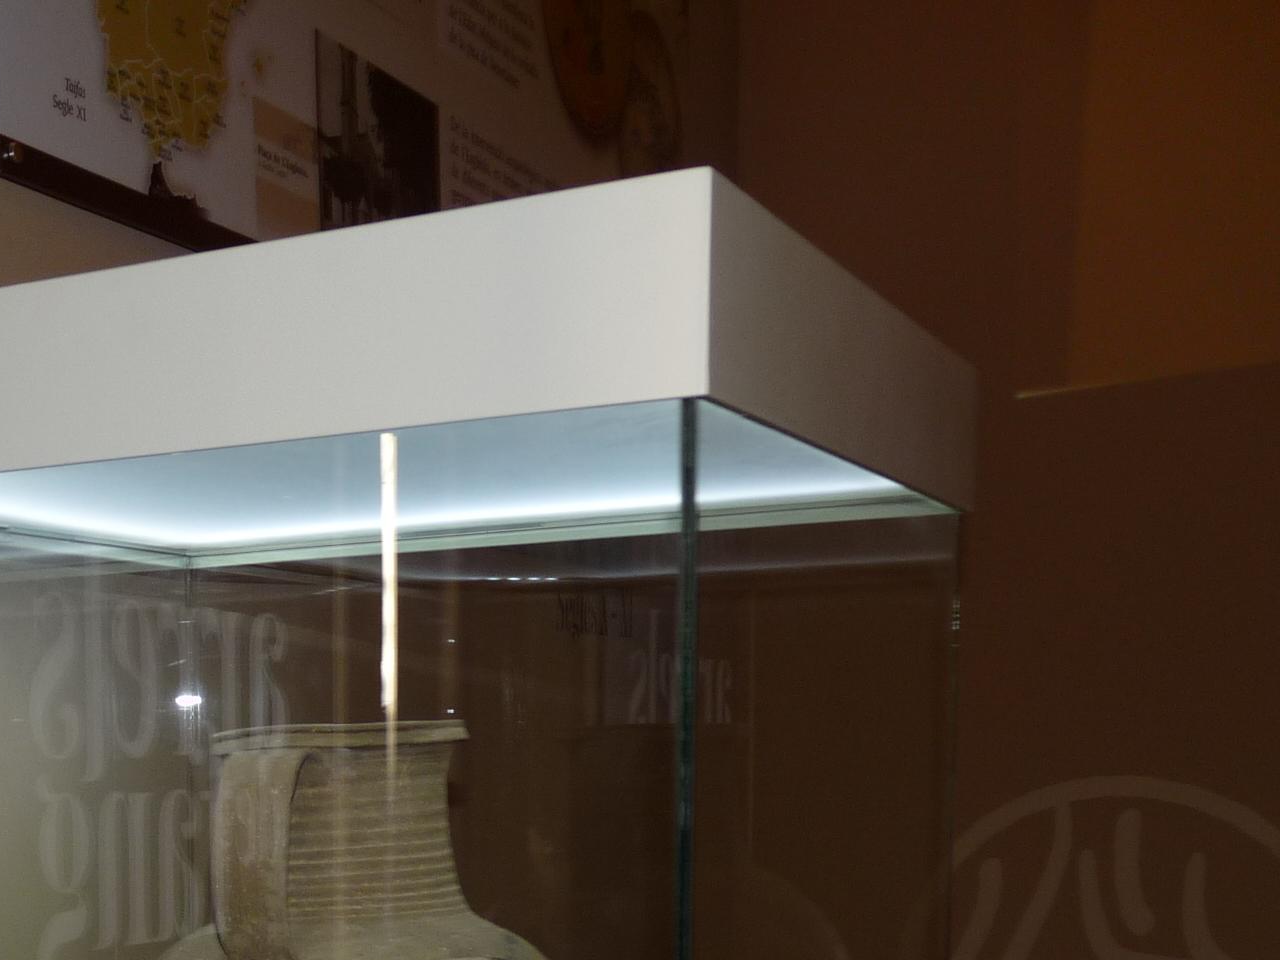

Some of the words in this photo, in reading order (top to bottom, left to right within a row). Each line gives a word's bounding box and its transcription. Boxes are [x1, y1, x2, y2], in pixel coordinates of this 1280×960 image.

[64, 77, 86, 99] Taifas
[52, 94, 74, 117] Segle
[76, 105, 87, 122] XI
